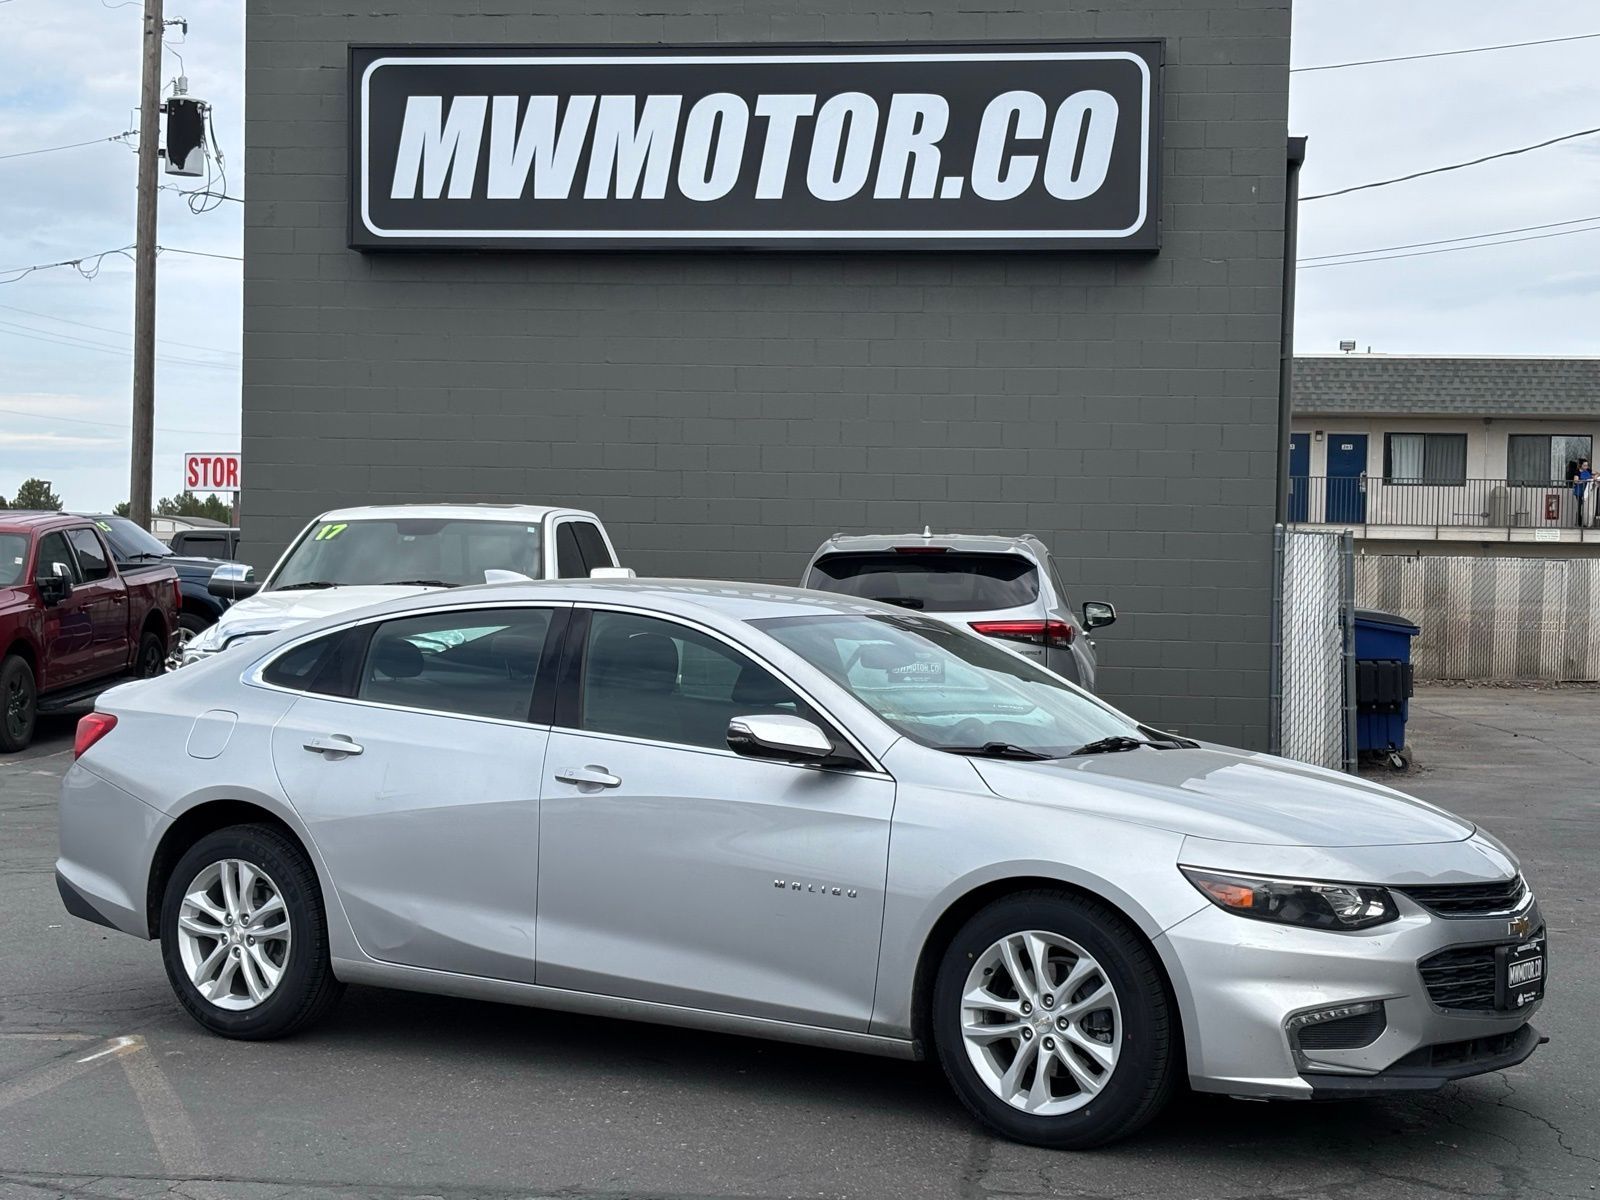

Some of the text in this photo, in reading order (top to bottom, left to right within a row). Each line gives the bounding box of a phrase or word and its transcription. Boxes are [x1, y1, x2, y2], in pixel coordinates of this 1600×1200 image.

[390, 89, 1120, 202] MWMOTOR.CO
[188, 457, 238, 487] STOR
[315, 524, 348, 540] 17
[774, 880, 857, 899] MALIBU
